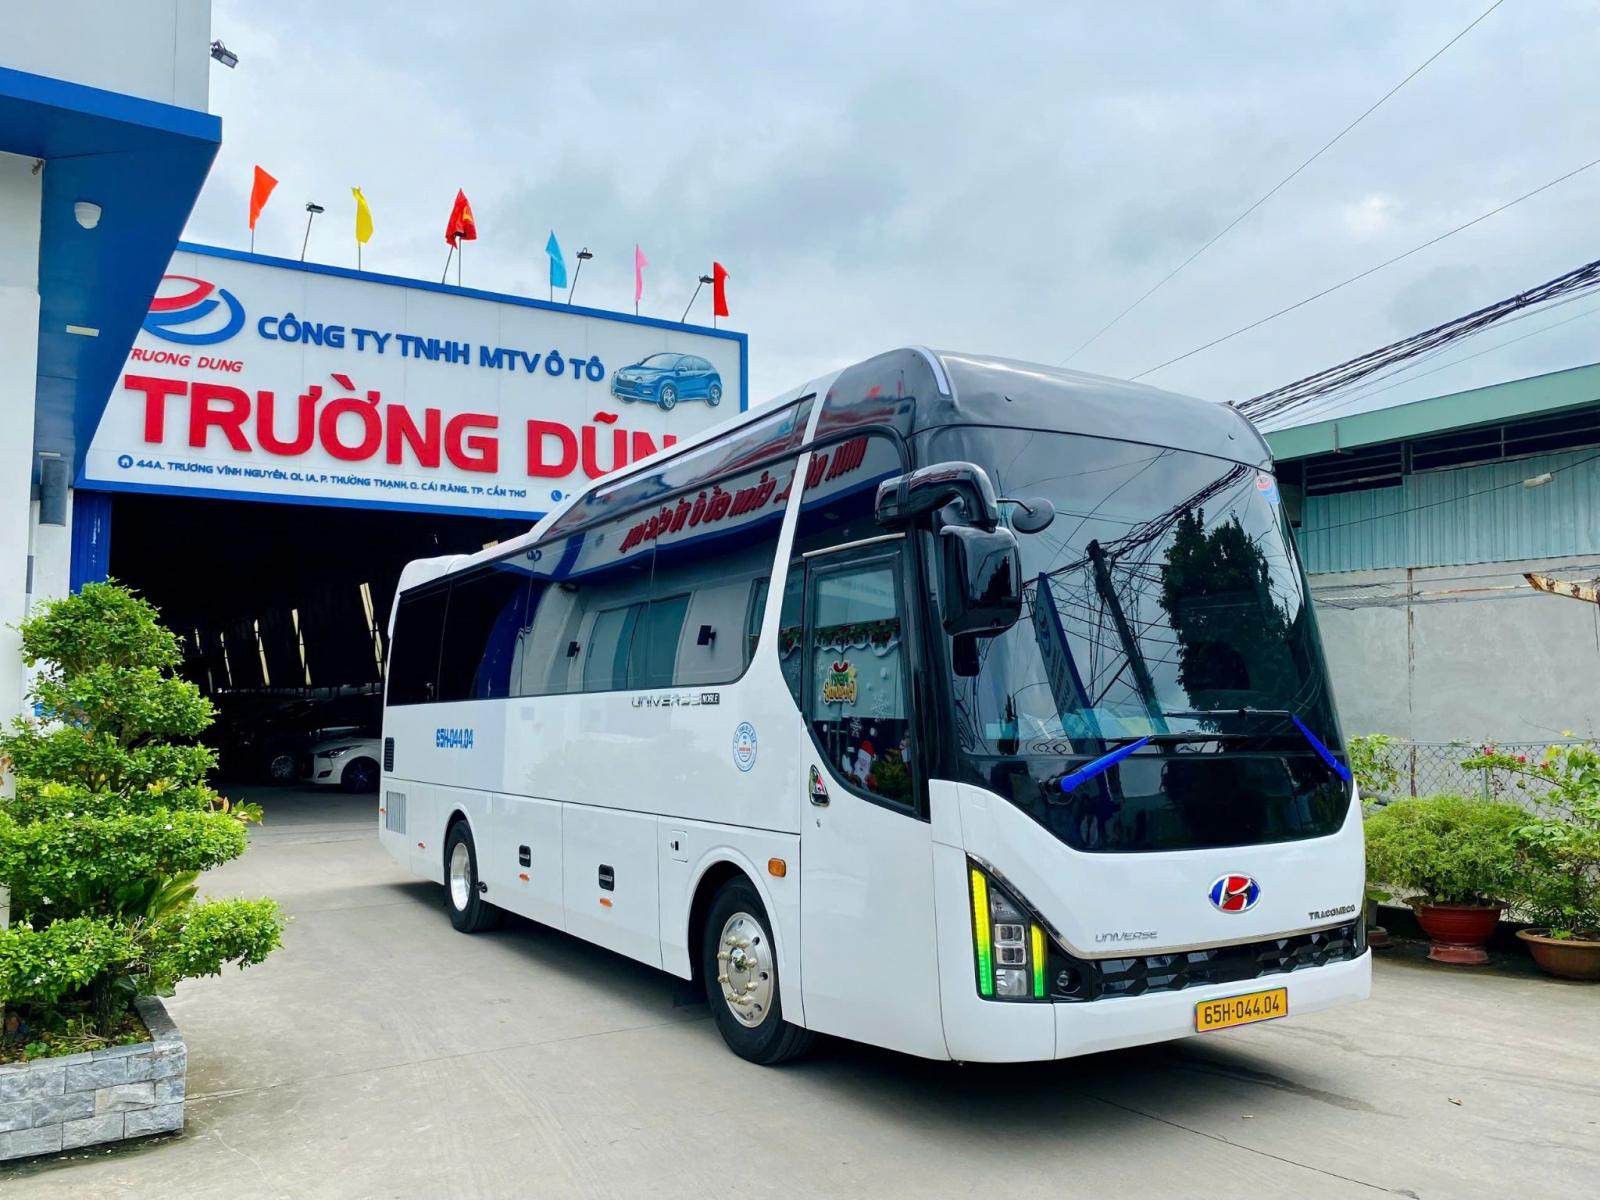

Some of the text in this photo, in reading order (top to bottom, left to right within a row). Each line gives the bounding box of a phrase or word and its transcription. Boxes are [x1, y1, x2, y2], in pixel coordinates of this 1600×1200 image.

[258, 312, 605, 382] CÔNG TY TNHH MTV Ô TÔ
[131, 348, 244, 373] RUONG DUNG
[124, 373, 499, 474] TRƯỜNG
[631, 694, 701, 708] UNIVERSE
[1308, 904, 1356, 921] TRACOMECO
[1095, 930, 1159, 943] UNIVERSE
